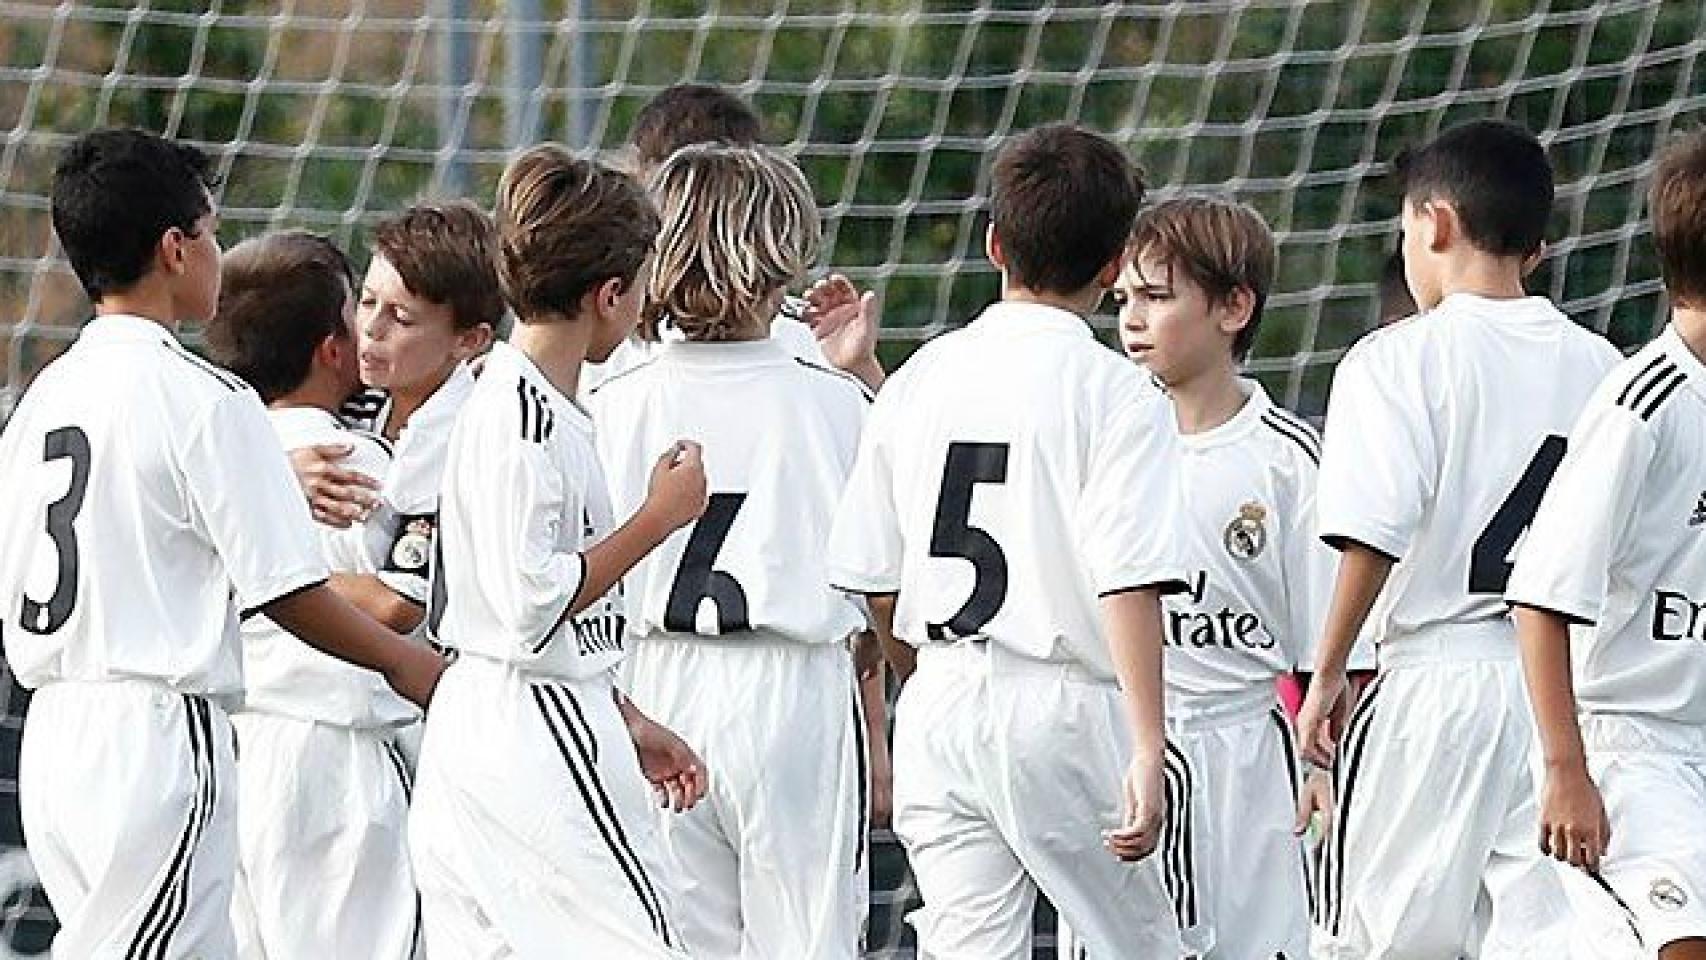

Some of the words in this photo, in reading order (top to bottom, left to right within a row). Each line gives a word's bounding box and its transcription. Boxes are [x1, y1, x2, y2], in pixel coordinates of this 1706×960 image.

[20, 425, 91, 635] 3
[663, 491, 750, 633] 6
[926, 441, 1009, 640] 5
